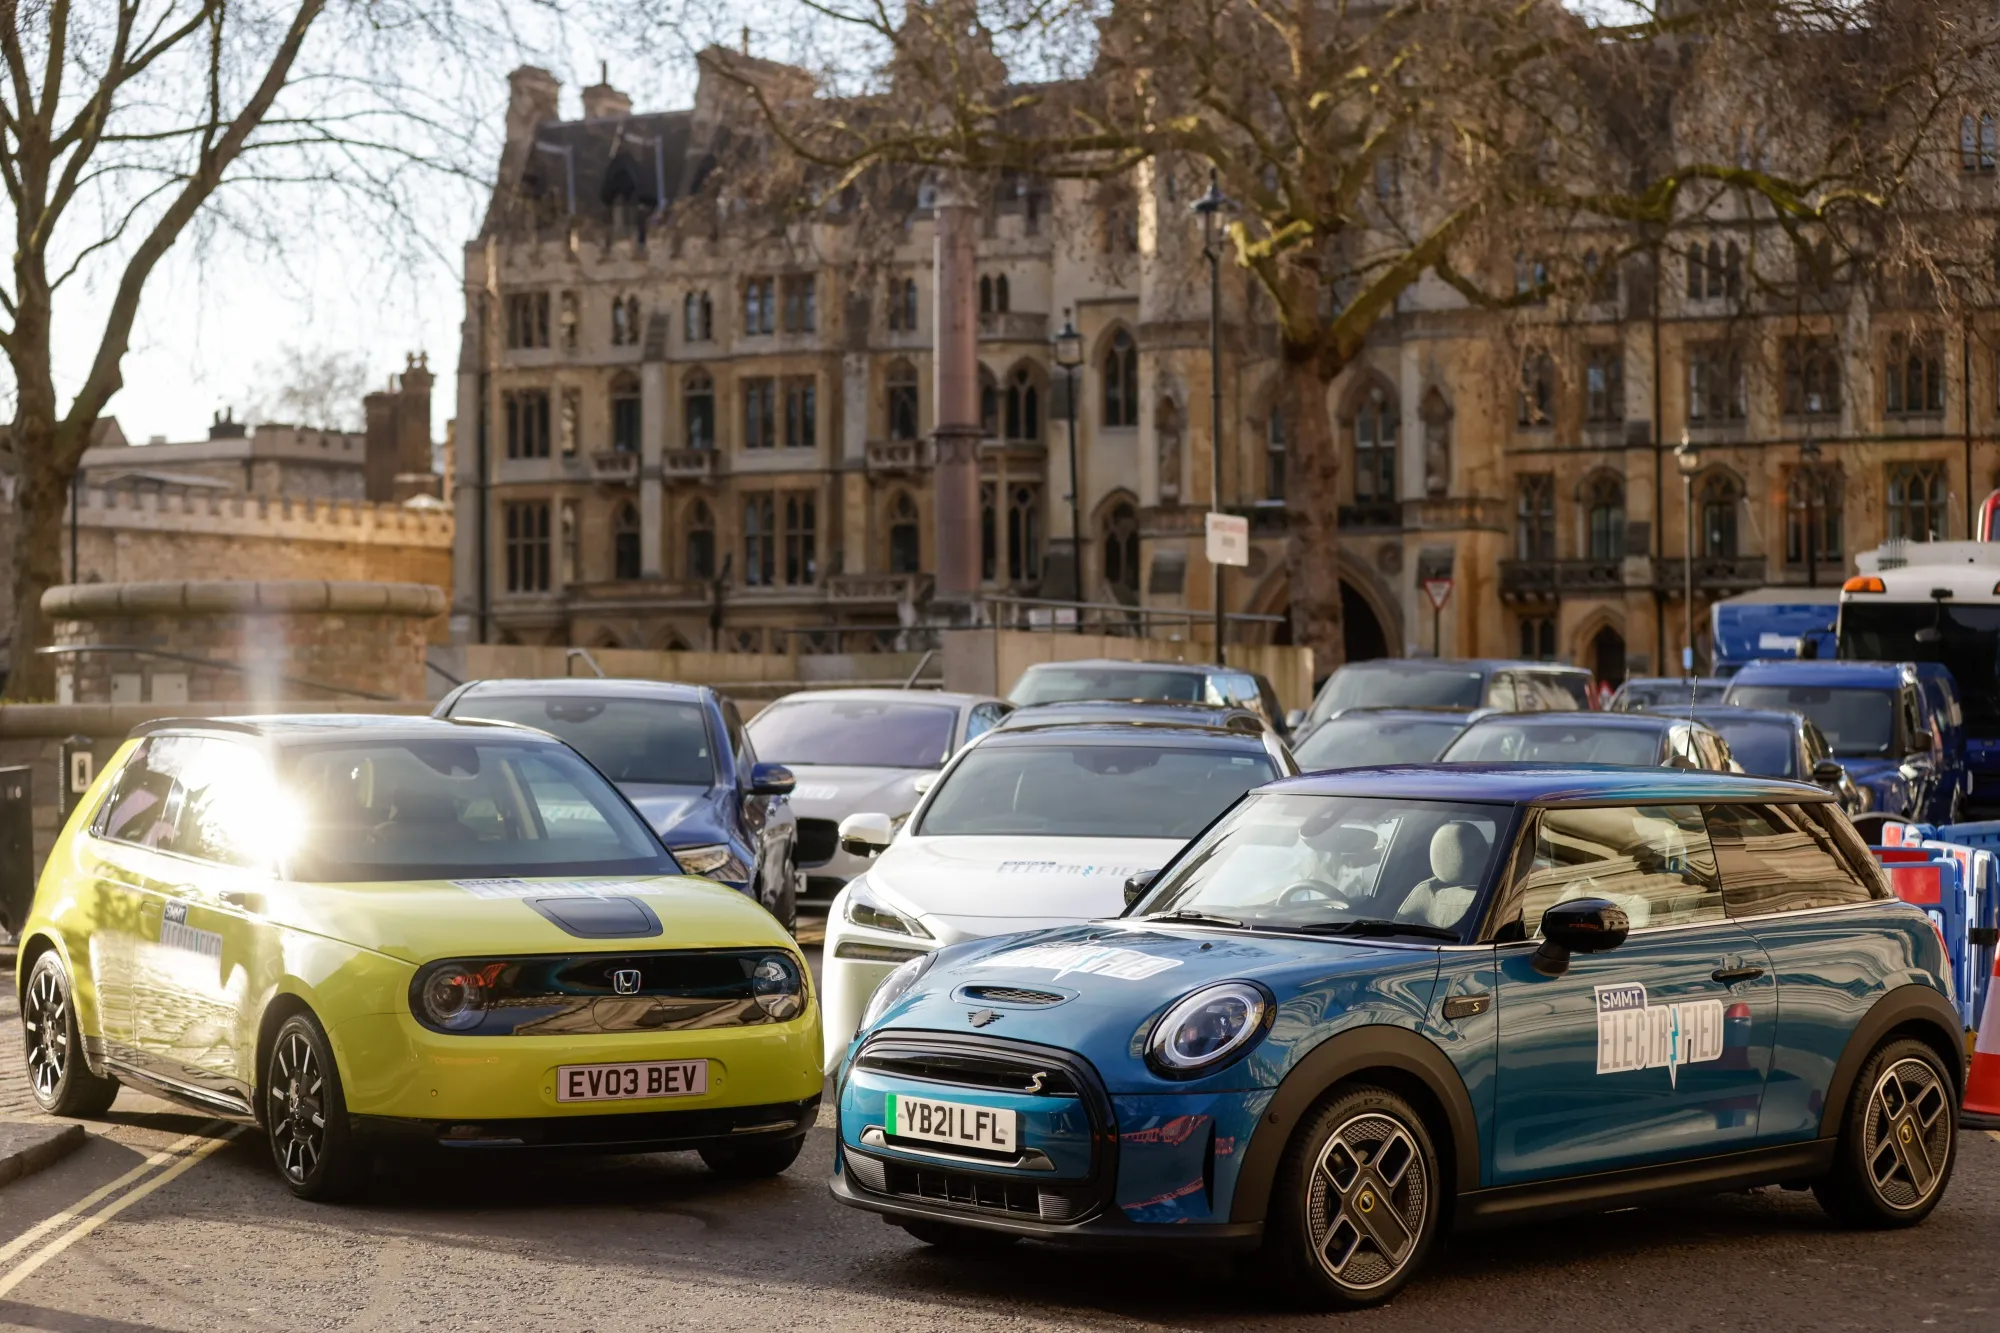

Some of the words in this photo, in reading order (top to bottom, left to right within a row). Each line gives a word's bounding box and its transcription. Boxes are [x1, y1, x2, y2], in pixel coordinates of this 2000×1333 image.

[1602, 990, 1640, 1008] SMMT
[569, 1068, 638, 1098] EV03
[647, 1065, 697, 1094] BEV
[1025, 1072, 1046, 1093] S
[905, 1101, 953, 1138] YB21
[961, 1109, 1006, 1145] LFL
